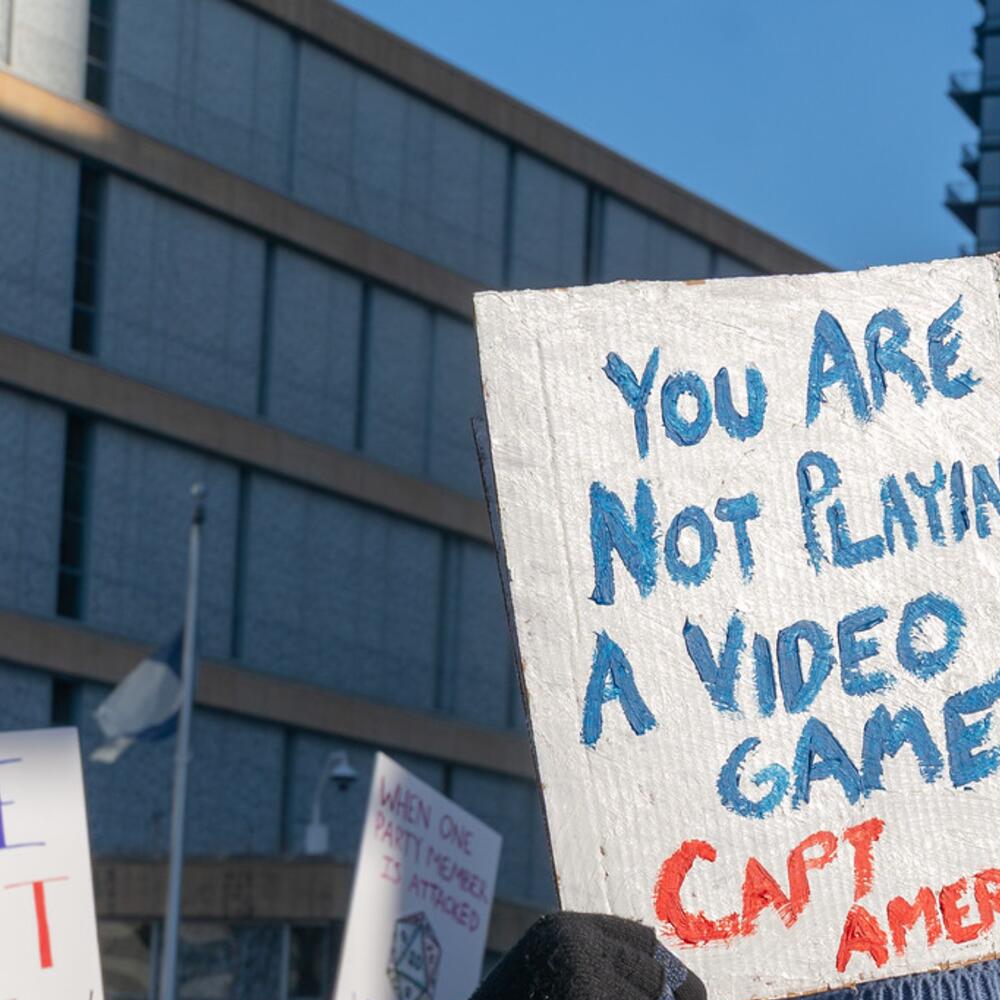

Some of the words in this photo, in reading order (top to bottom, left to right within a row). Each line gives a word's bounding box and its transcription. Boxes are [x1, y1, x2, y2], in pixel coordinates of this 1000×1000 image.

[602, 347, 767, 459] YOU
[805, 295, 981, 428] ARE
[589, 478, 760, 606] NOT
[580, 630, 657, 747] A
[683, 592, 967, 718] VIDEO
[374, 810, 423, 866] PARTY
[426, 844, 488, 904] MEMBER
[379, 775, 432, 829] WHEN
[438, 814, 474, 856] ONE
[381, 854, 401, 886] IS
[408, 873, 481, 933] ATTACKED
[654, 818, 886, 948] CAPT
